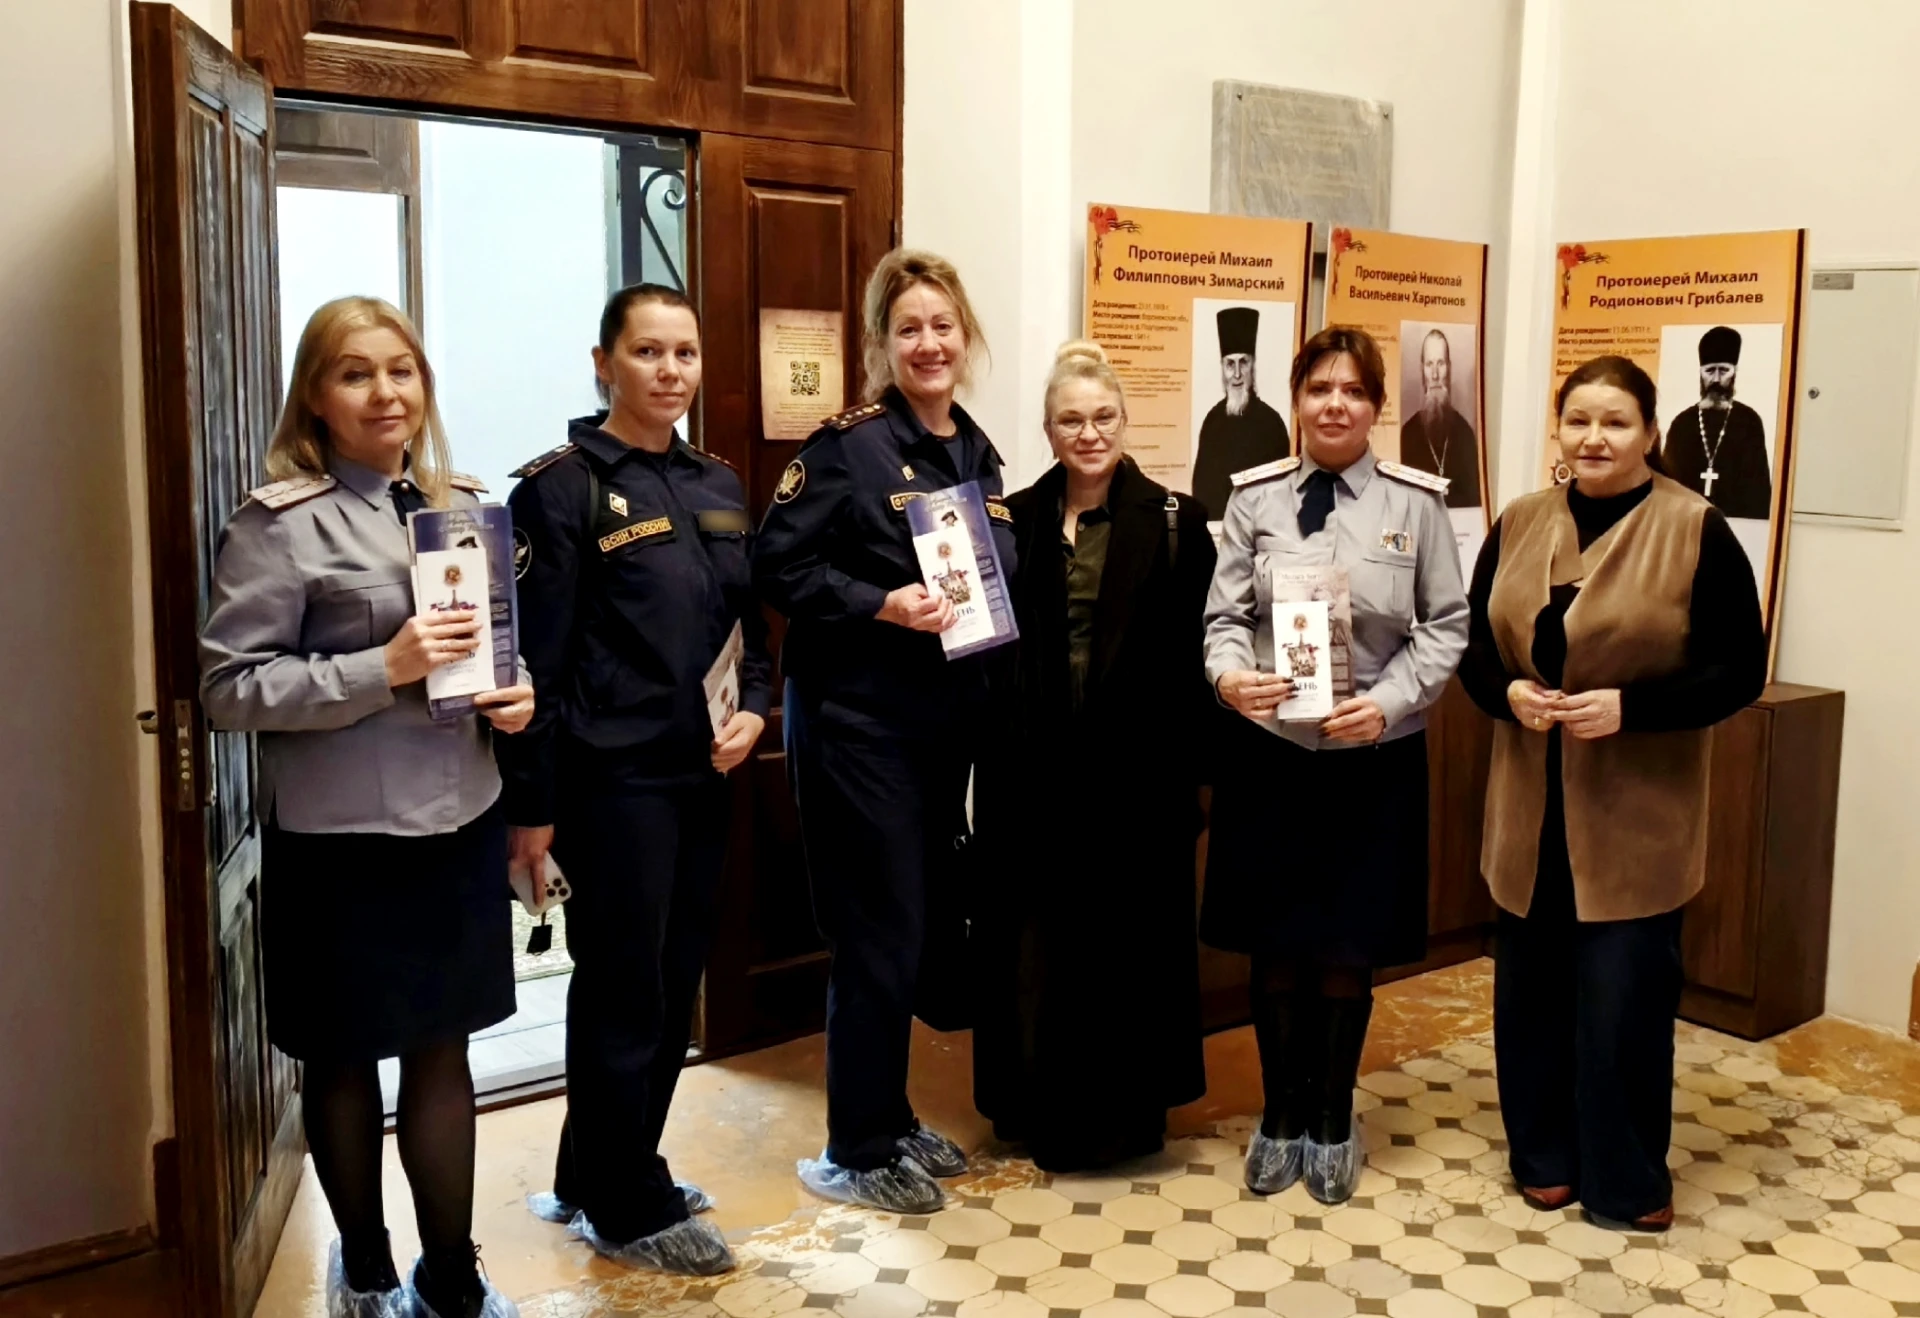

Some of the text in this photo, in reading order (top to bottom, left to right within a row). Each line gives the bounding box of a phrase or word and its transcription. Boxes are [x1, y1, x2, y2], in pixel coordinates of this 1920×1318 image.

[1128, 245, 1273, 269] Протоиерей Михаил
[1113, 266, 1285, 292] Филиппович Зимарский
[1355, 265, 1463, 287] Протоиерей Николай
[1596, 271, 1759, 290] Протоиерей Михаил
[1349, 285, 1466, 307] Васильевич Харитонов
[1589, 292, 1764, 309] Родионович Грибалев
[630, 519, 669, 537] РОССИИ
